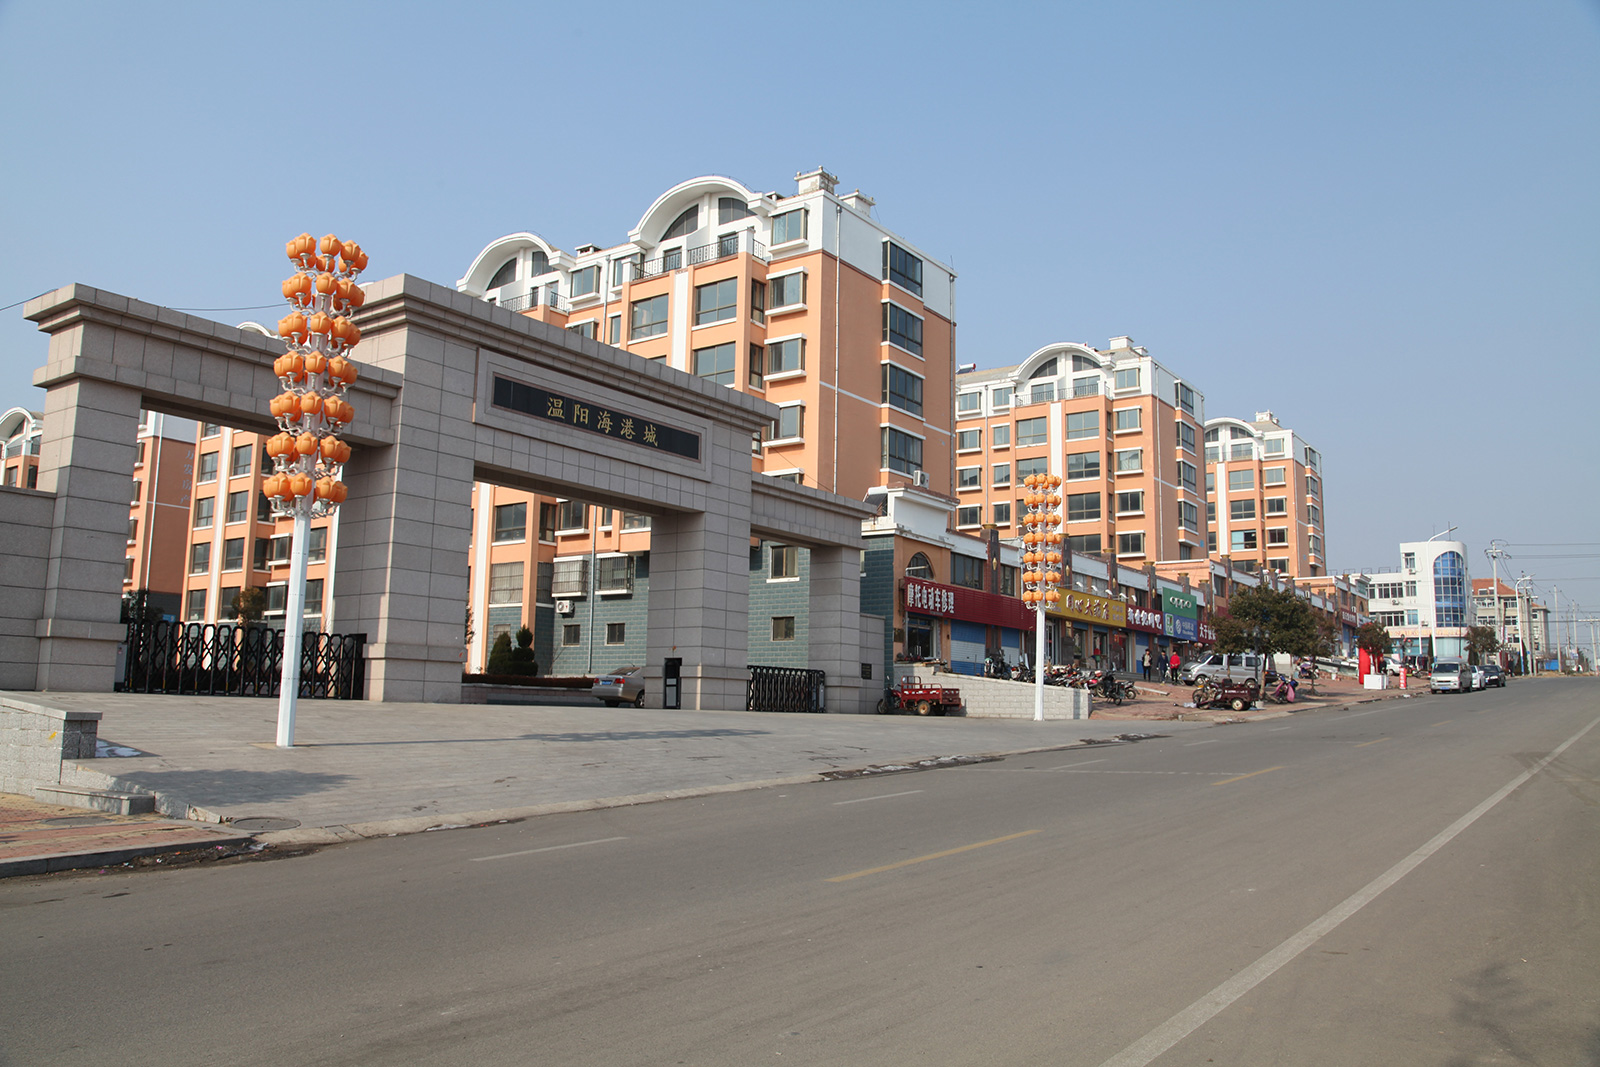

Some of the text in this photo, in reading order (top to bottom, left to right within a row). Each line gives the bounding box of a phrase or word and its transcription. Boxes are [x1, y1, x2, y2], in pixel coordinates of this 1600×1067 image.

[547, 397, 658, 447] 温阳海港城
[907, 582, 955, 614] 摩托电动车修理
